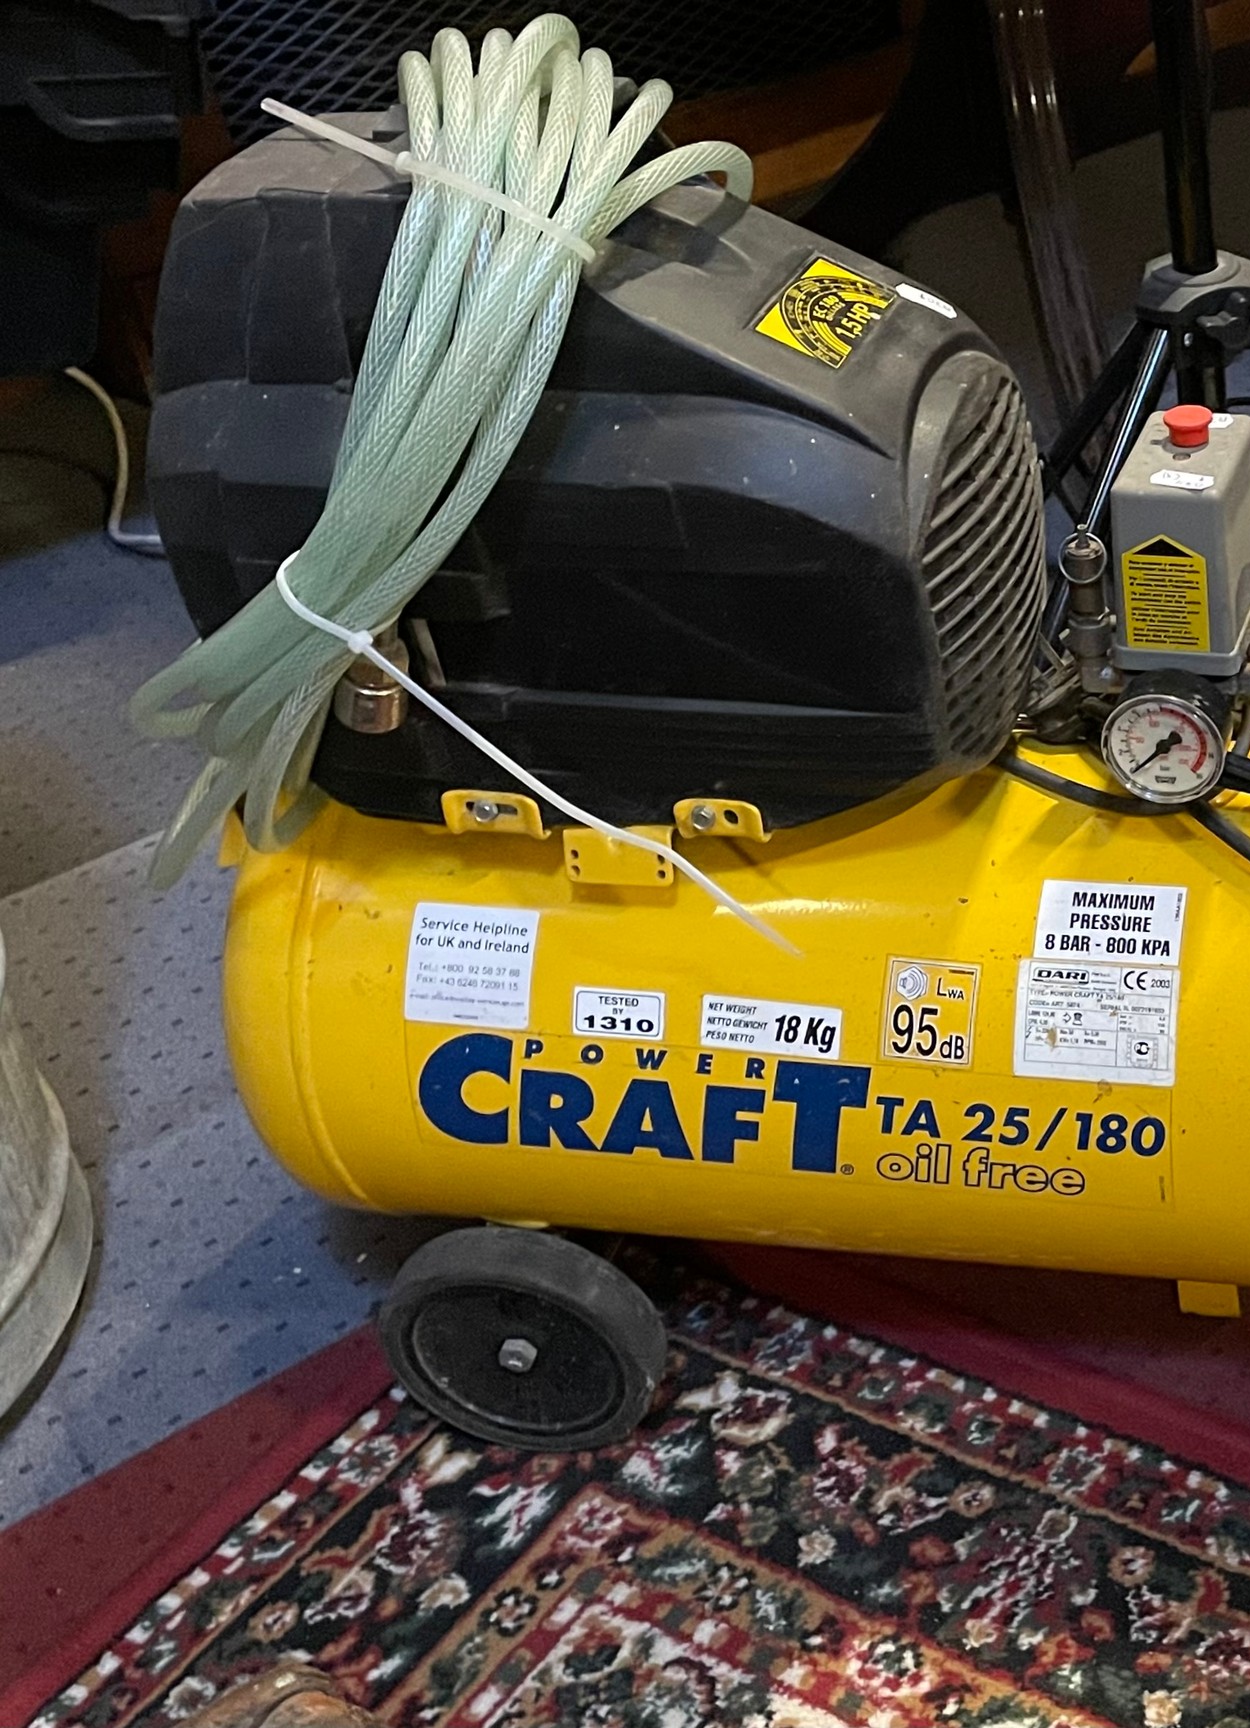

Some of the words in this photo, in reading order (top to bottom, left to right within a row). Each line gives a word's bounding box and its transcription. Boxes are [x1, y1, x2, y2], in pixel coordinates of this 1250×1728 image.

[846, 302, 872, 324] HP
[1072, 891, 1155, 911] MAXIMUM
[421, 917, 469, 932] Service
[473, 921, 528, 937] Helpline
[1069, 913, 1152, 933] PRESSURE
[416, 933, 434, 946] for
[437, 935, 455, 948] UK
[458, 938, 482, 950] and
[484, 940, 530, 954] Ireland
[1045, 933, 1056, 950] 8
[1059, 934, 1091, 952] BAR
[1106, 937, 1137, 955] 800
[1141, 939, 1170, 957] KPA
[468, 965, 480, 975] 92
[495, 967, 507, 977] 37
[1037, 969, 1087, 981] DARI
[1151, 979, 1171, 989] 2003
[440, 977, 455, 986] +43
[508, 982, 519, 991] 15
[598, 995, 639, 1007] TESTED
[612, 1007, 624, 1015] BY
[708, 1002, 724, 1012] NET
[725, 1004, 757, 1015] WEIGHT
[583, 1015, 654, 1033] 1310
[707, 1016, 732, 1027] NETTO
[732, 1019, 768, 1031] GEWICHT
[892, 1004, 938, 1056] 95
[940, 1034, 965, 1060] dB
[705, 1030, 728, 1040] PESO
[728, 1033, 755, 1044] NETTO
[775, 1014, 801, 1043] 18
[803, 1017, 836, 1054] Kg
[523, 1039, 766, 1080] POWER
[418, 1032, 872, 1174] CRAFT
[876, 1096, 941, 1138] TA
[961, 1102, 1166, 1157] 25/180
[876, 1142, 952, 1185] oil
[962, 1146, 1086, 1196] free
